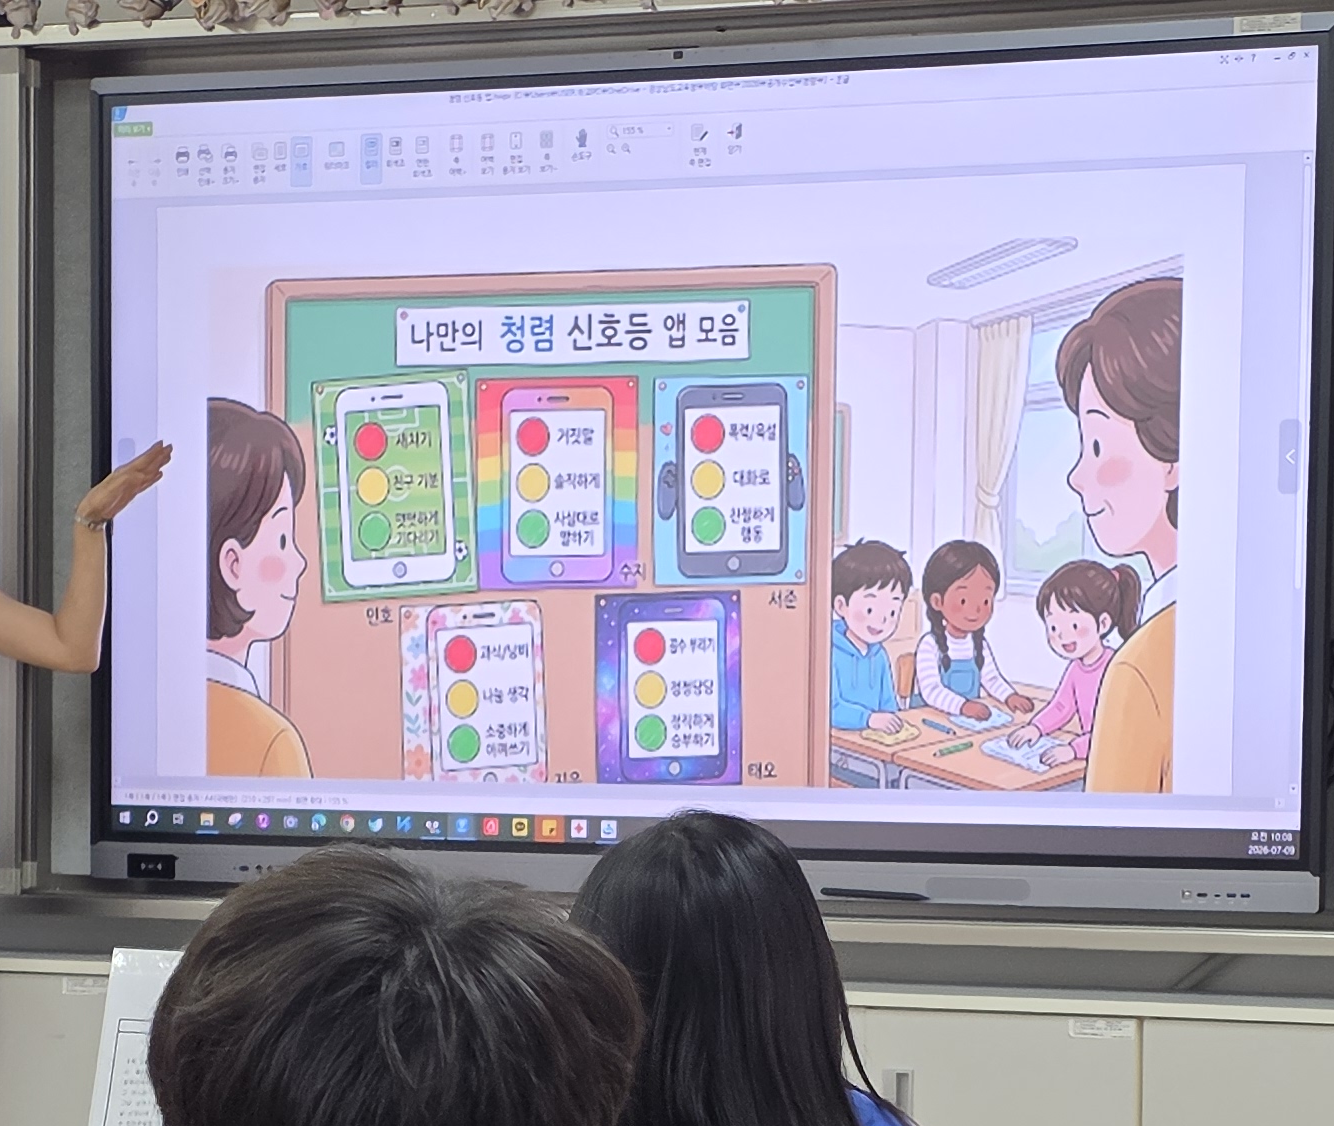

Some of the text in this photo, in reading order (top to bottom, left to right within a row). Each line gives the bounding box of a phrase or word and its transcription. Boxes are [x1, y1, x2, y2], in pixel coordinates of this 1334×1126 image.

[410, 312, 740, 353] 나만의 청렴 신호등 앱 모음
[556, 427, 595, 446] 거짓말
[393, 471, 438, 491] 친구 기분
[554, 472, 601, 490] 솔직하게
[554, 510, 600, 527] 사실대로
[560, 530, 594, 547] 말하기
[619, 562, 647, 582] 수지
[507, 685, 529, 703] 생각
